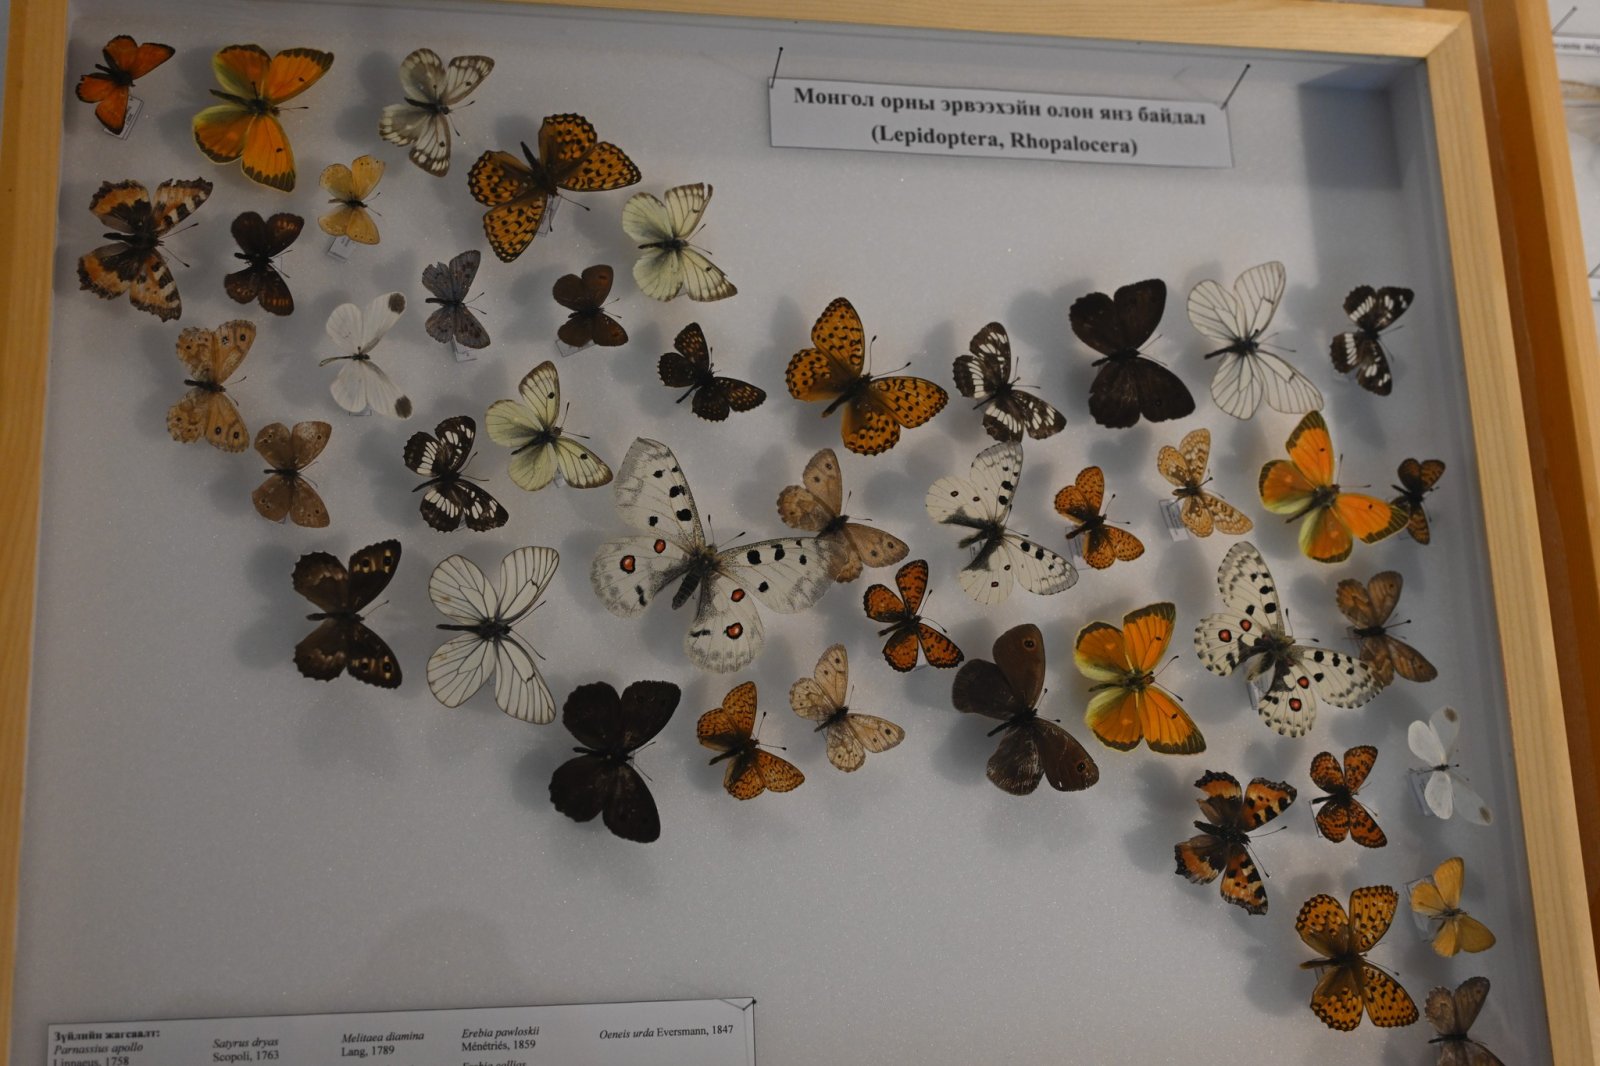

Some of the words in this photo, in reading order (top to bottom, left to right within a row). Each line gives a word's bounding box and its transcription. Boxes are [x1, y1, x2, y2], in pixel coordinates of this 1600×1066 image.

[794, 87, 874, 108] Монгол
[881, 95, 935, 115] орны
[941, 98, 1041, 118] эрвээхэйн
[1047, 103, 1093, 120] олон
[1100, 107, 1133, 122] янз
[1138, 106, 1206, 126] байдал
[871, 124, 1005, 150] (Lepidoptera,
[1010, 132, 1137, 157] Rhopalocera)
[341, 1033, 383, 1044] Melitaea
[385, 1031, 424, 1042] diamina
[462, 1027, 493, 1038] Erebia
[494, 1026, 540, 1040] pawloskii
[599, 1029, 630, 1039] Oeneis
[633, 1027, 654, 1038] urda
[656, 1026, 709, 1038] Eversmann,
[712, 1024, 734, 1034] 1847
[54, 1044, 109, 1056] Parnassius
[111, 1041, 144, 1053] apollo
[212, 1038, 249, 1050] Satyrus
[251, 1037, 279, 1049] dryas
[513, 1039, 536, 1050] 1859
[212, 1051, 252, 1063] Scopoli,
[256, 1049, 280, 1061] 1763
[341, 1046, 368, 1058] Lang,
[371, 1045, 395, 1056] 1789
[105, 1056, 130, 1066] 1758
